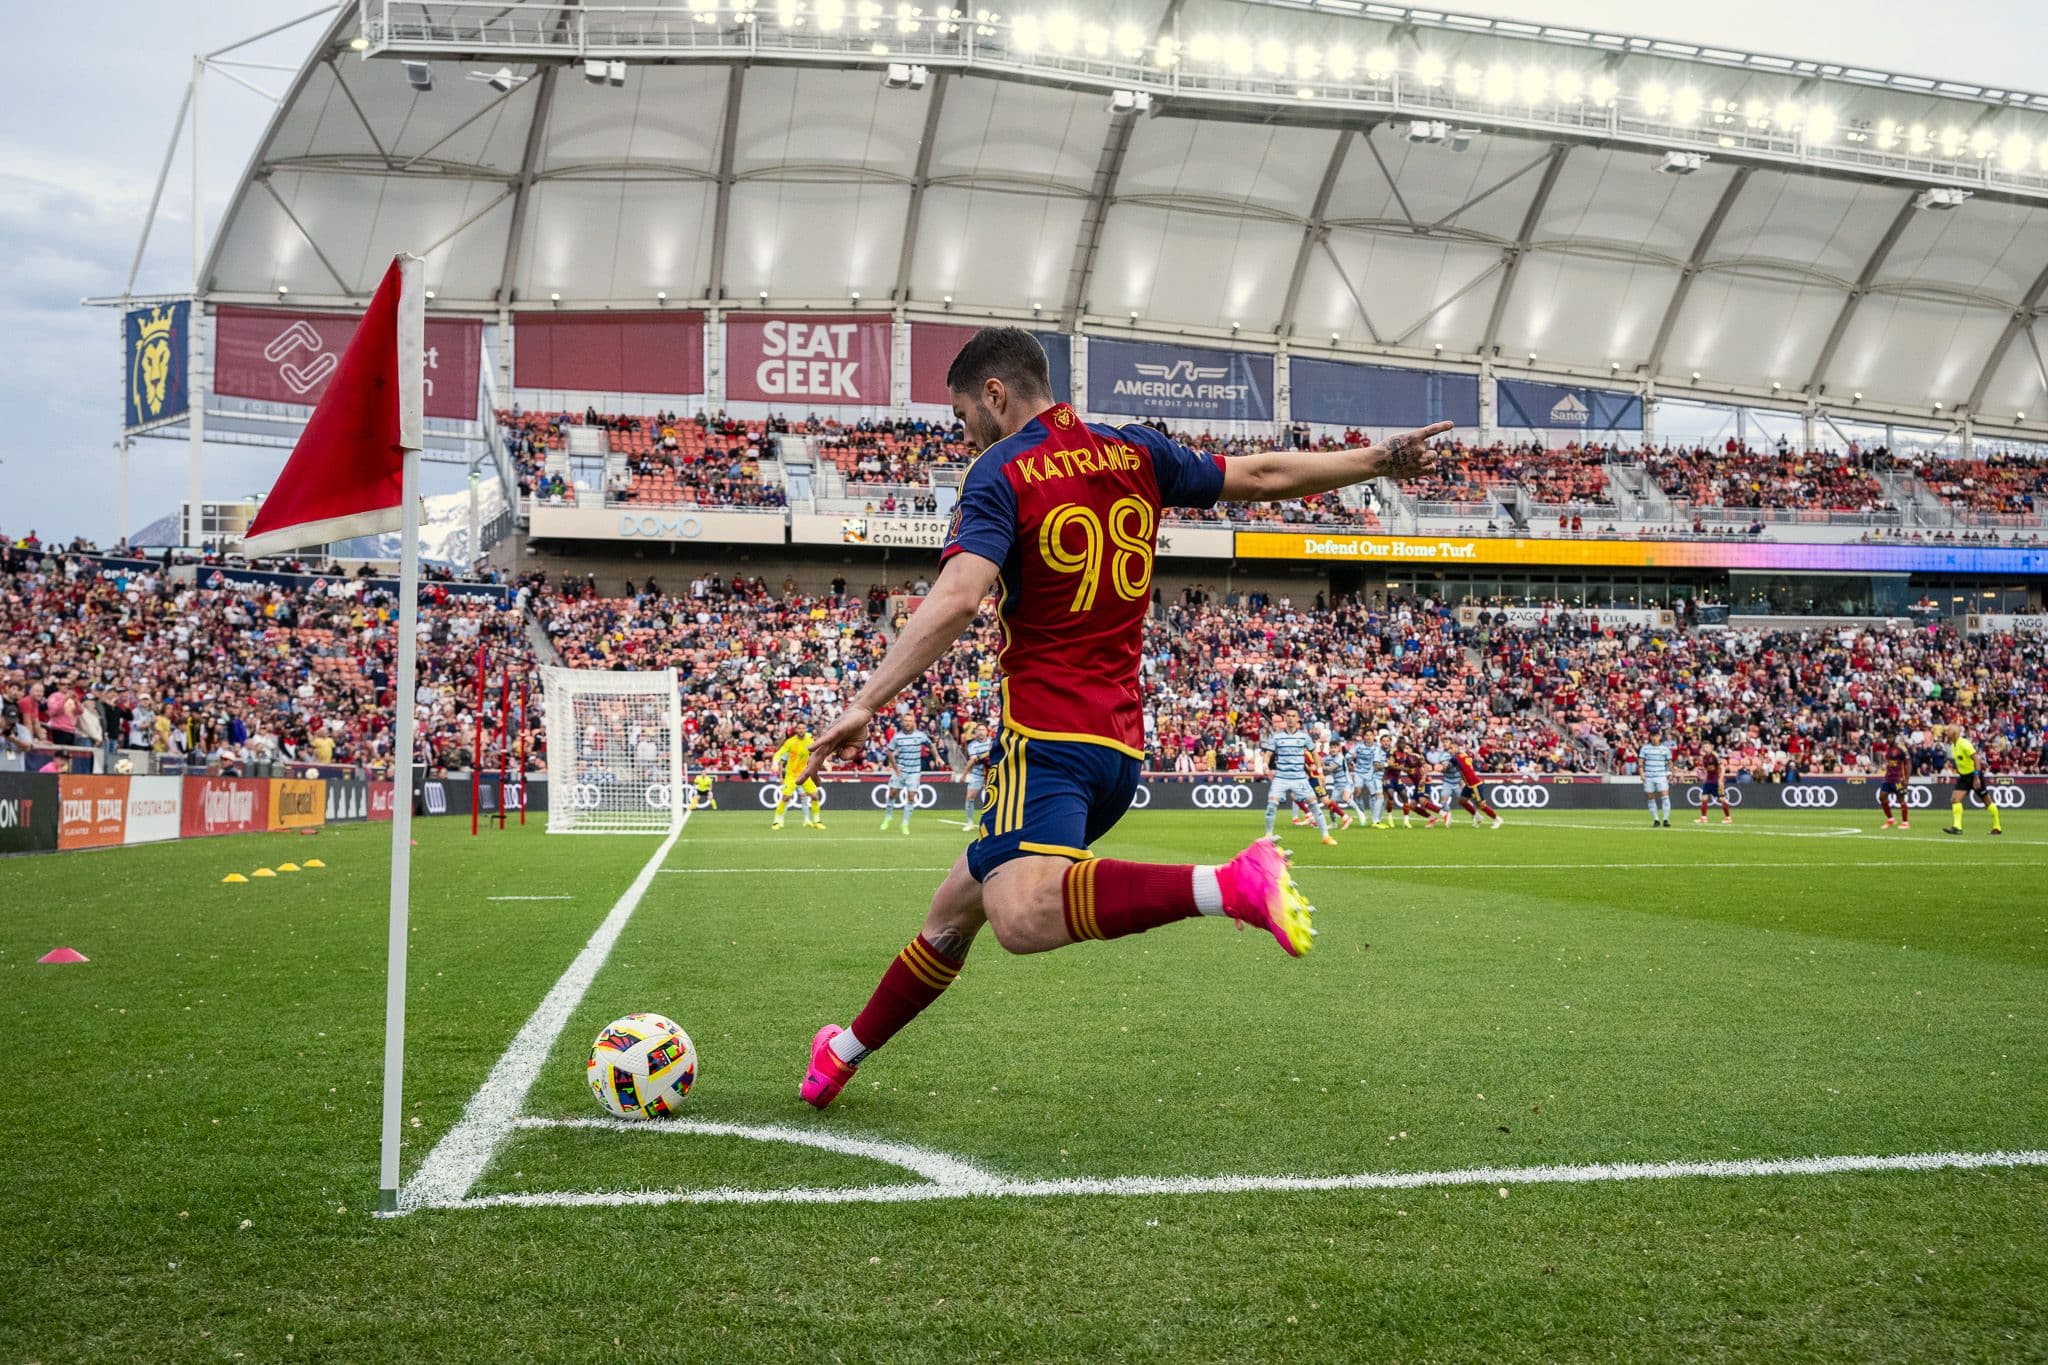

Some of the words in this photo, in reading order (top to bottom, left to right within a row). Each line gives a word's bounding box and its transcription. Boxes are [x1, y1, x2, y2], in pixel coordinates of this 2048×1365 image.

[763, 320, 857, 358] SEAT
[756, 359, 861, 398] GEEK
[1113, 379, 1194, 398] AMERICA
[1197, 384, 1249, 400] FIRST
[1144, 398, 1181, 407] CREDIT
[1187, 400, 1219, 409] UNION
[1550, 410, 1590, 424] Sandy
[618, 512, 703, 538] DOMO
[873, 534, 946, 546] COMMISSI
[1304, 539, 1358, 555] Defend
[1360, 541, 1390, 555] Our
[1391, 542, 1437, 557] Home
[1438, 542, 1477, 558] Turf.
[1038, 494, 1154, 613] 98
[20, 799, 33, 829] IT
[63, 799, 92, 824] UTAH
[96, 799, 122, 823] UTAH
